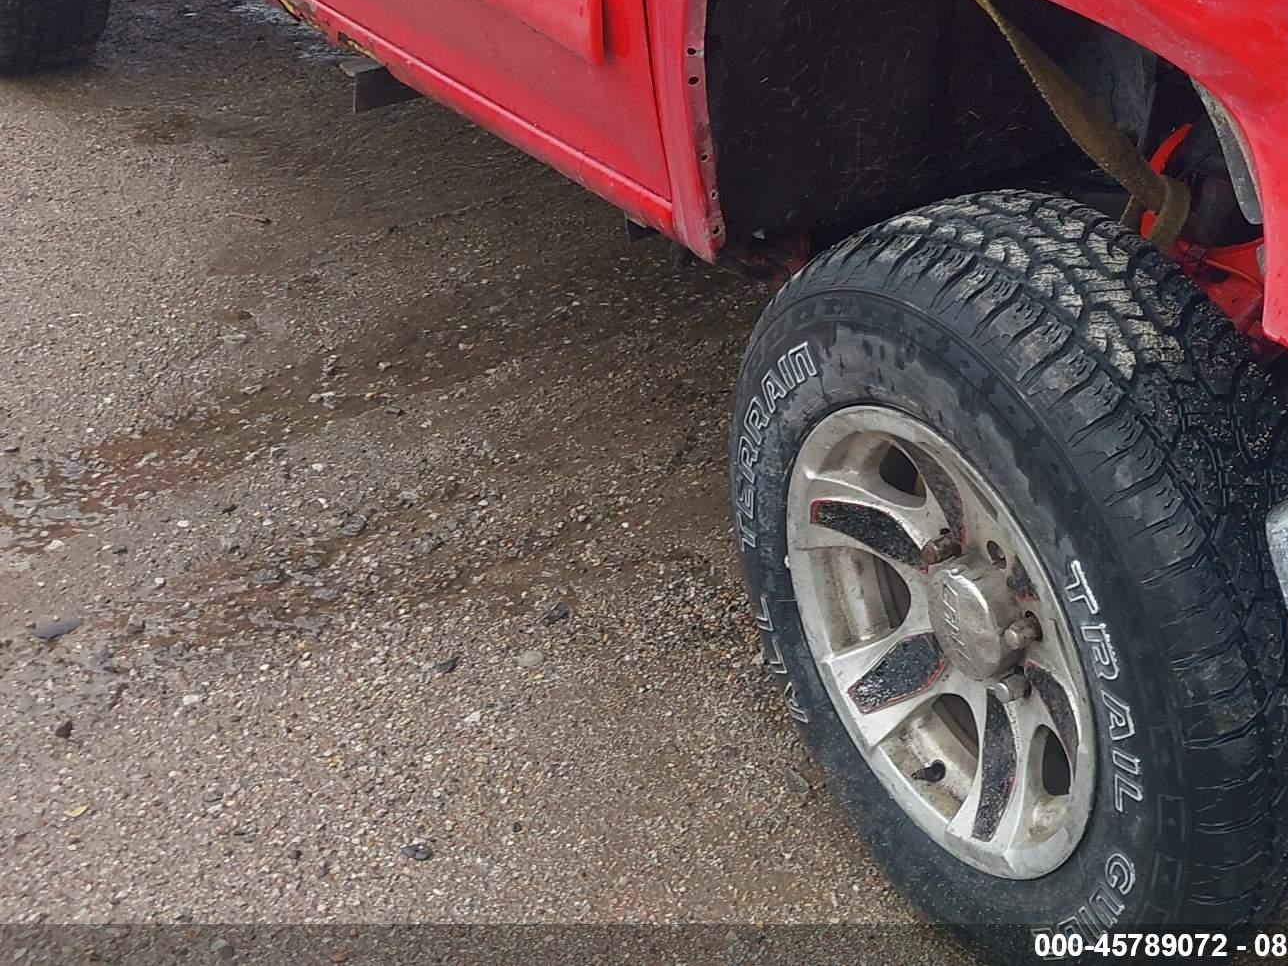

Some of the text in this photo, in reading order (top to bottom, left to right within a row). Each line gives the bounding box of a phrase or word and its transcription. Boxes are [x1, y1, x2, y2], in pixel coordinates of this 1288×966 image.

[735, 340, 818, 725] ALL TERRAIN
[1064, 559, 1144, 813] TRAIL
